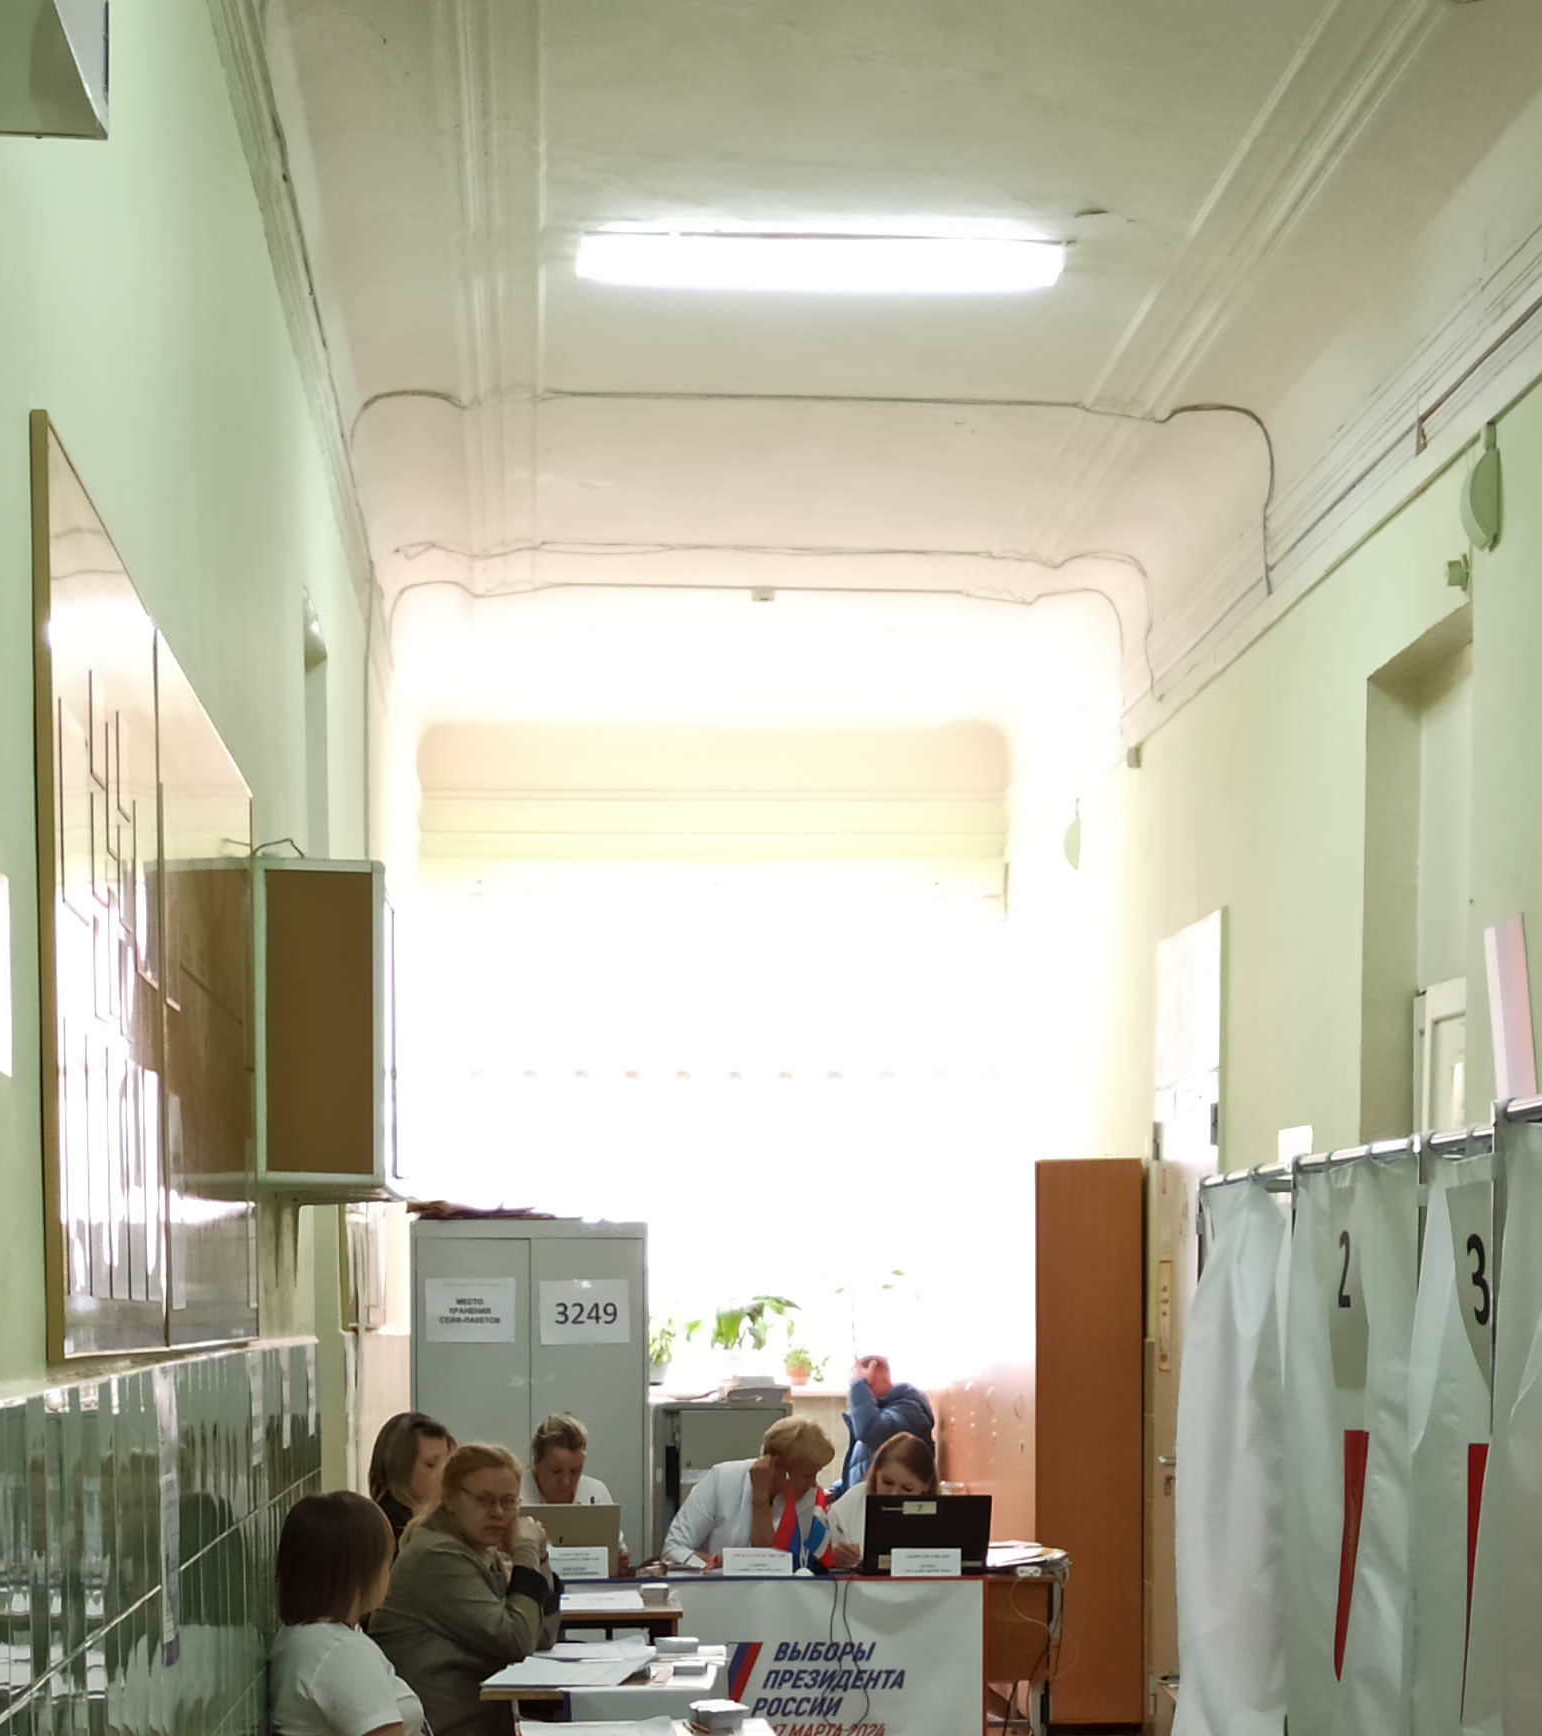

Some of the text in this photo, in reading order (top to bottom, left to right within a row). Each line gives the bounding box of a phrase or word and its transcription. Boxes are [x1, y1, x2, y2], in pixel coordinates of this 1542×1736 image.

[1338, 1230, 1351, 1308] 2
[1466, 1233, 1491, 1326] 3
[555, 1302, 618, 1325] 3249
[773, 1642, 876, 1662] ВЫБОРЫ
[762, 1669, 906, 1692] ПРЕЗИДЕНТА
[751, 1697, 843, 1717] РОССИИ
